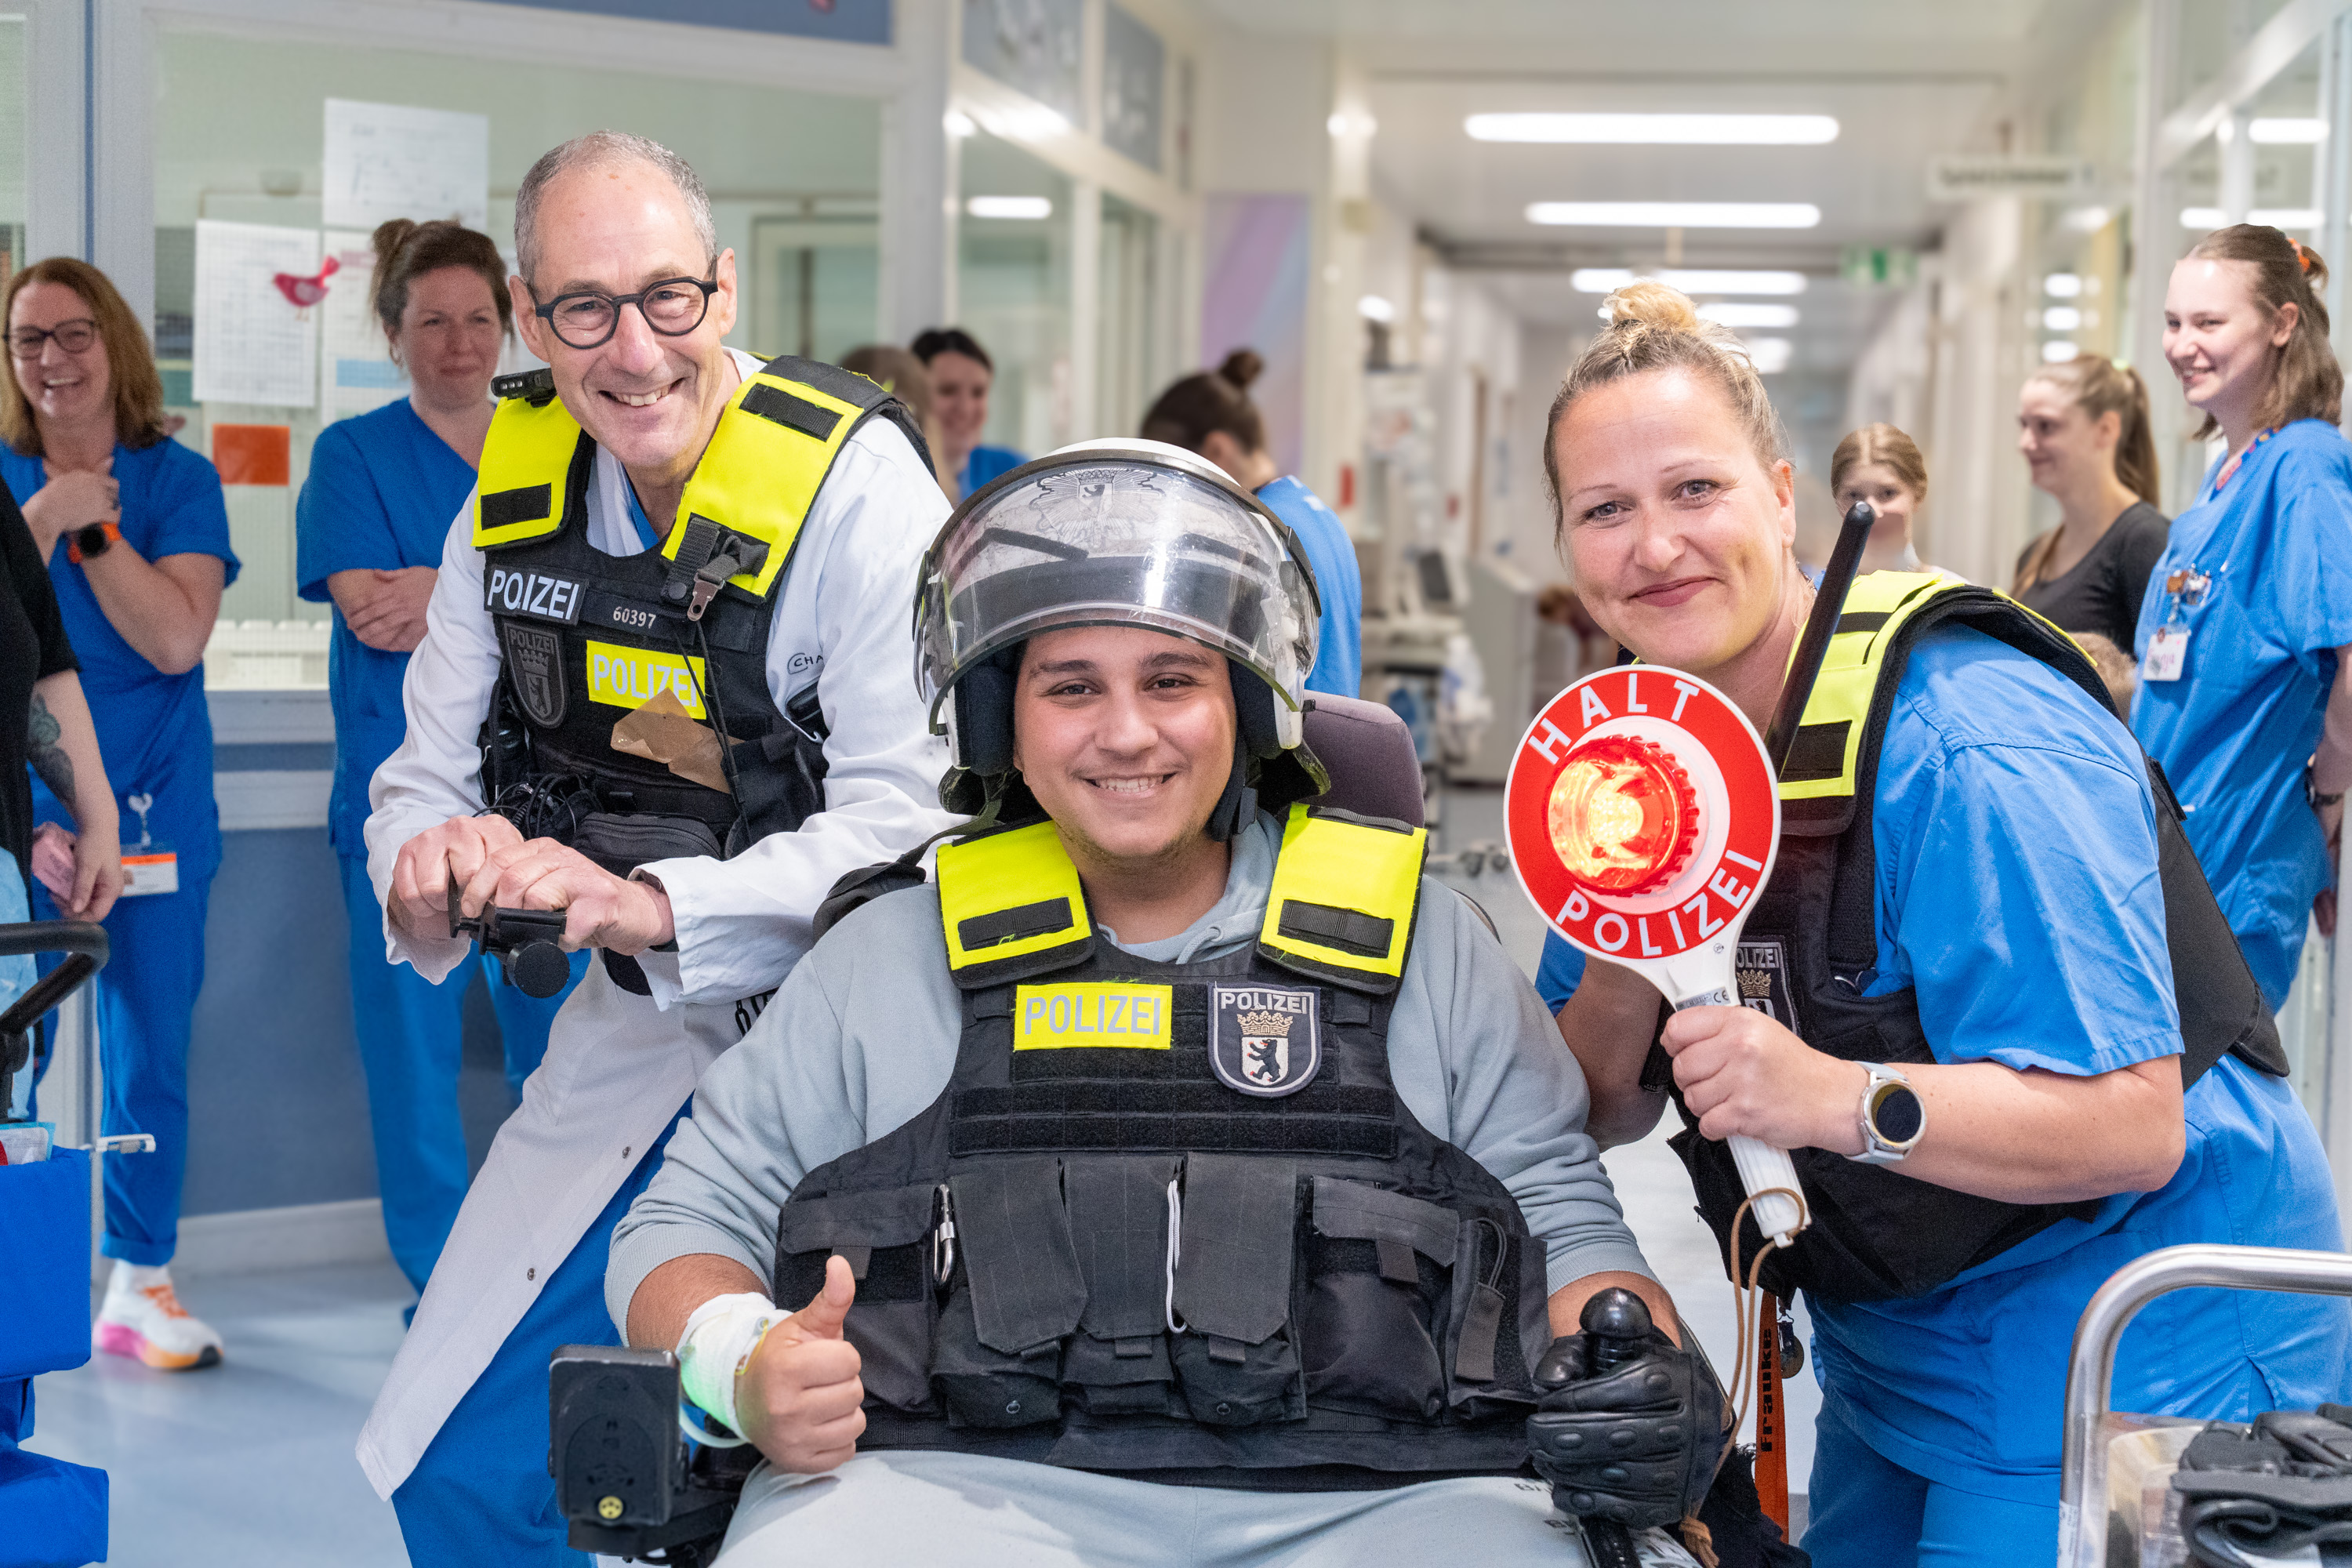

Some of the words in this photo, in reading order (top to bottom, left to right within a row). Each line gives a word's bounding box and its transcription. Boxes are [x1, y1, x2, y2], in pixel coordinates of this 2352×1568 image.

[613, 606, 656, 629] 60397
[510, 627, 555, 655] POLIZEI
[1528, 673, 1700, 765] HALT
[1555, 849, 1762, 957] POLIZEI
[1736, 947, 1780, 968] OLIZEI
[1025, 994, 1161, 1036] POLIZEI
[1221, 992, 1308, 1014] POLIZEI
[1761, 1329, 1773, 1452] Frauke
